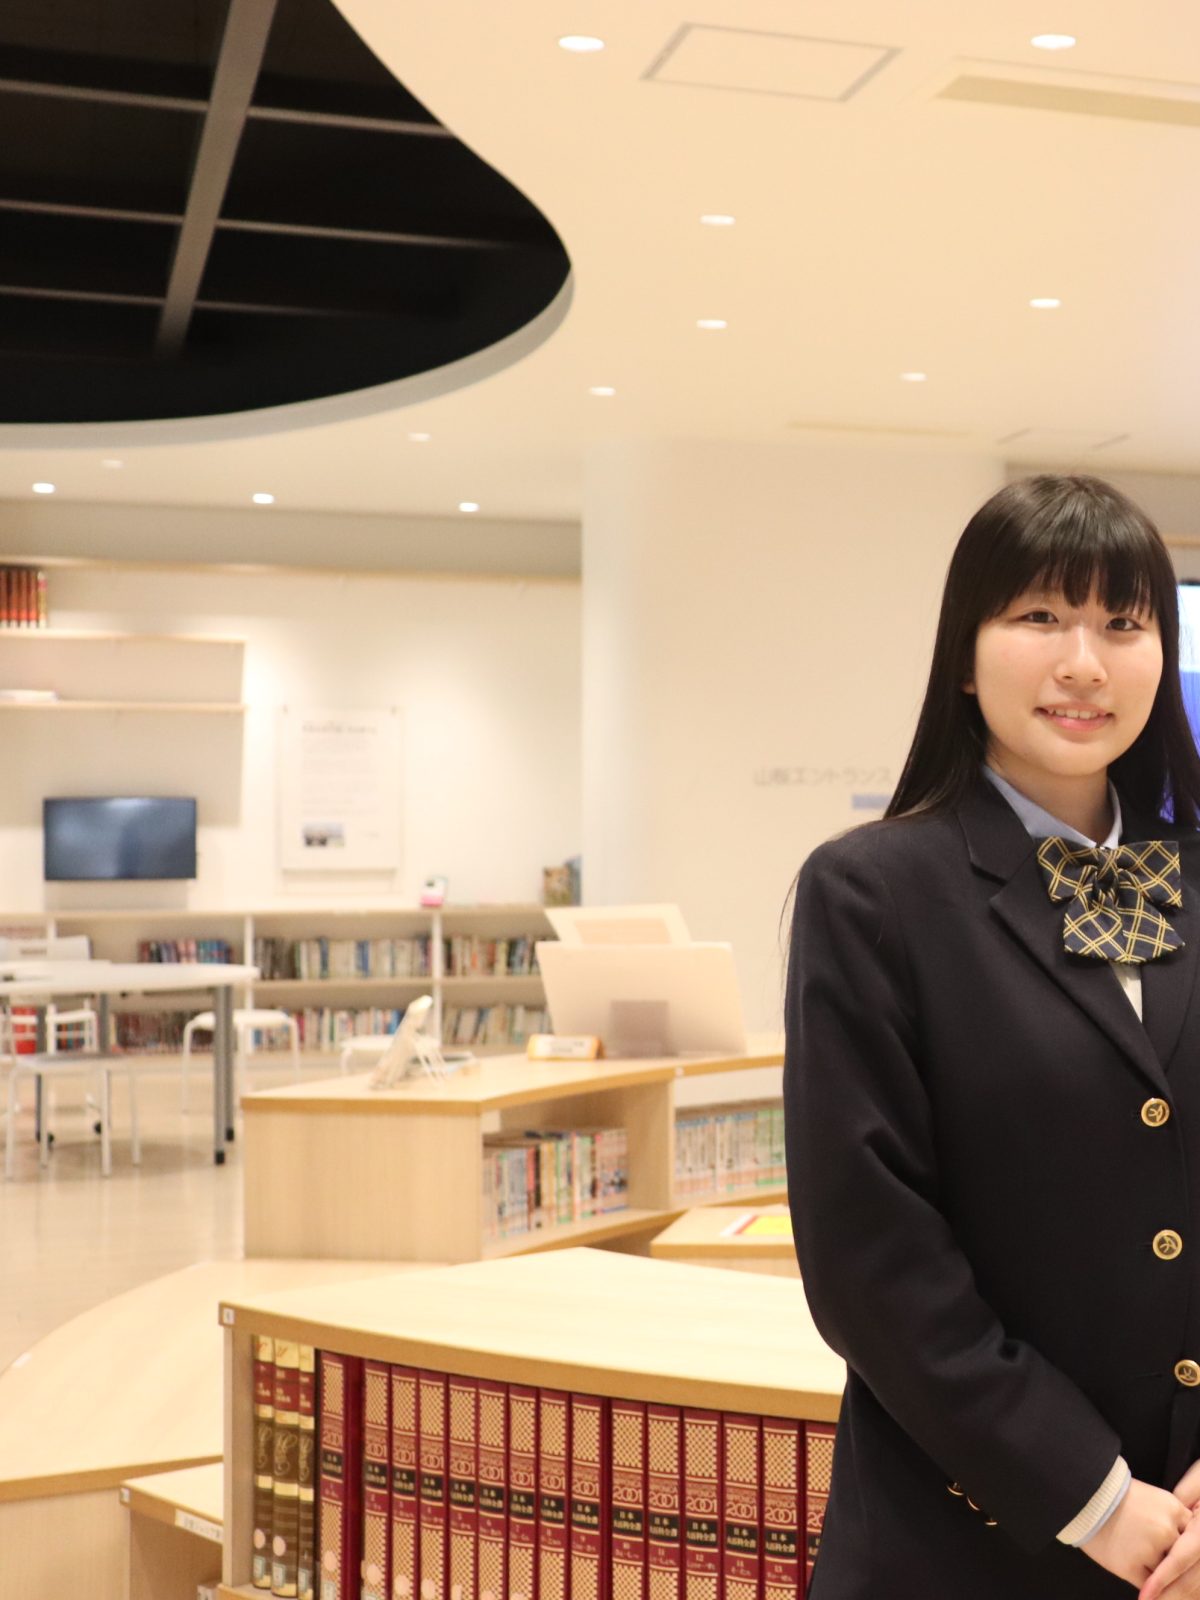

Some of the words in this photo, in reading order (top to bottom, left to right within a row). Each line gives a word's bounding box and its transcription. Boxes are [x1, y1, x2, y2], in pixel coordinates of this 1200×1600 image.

[613, 1485, 643, 1503] 2001
[649, 1491, 679, 1509] 2001
[686, 1496, 718, 1513] 2001
[726, 1501, 757, 1519] 2001
[765, 1507, 797, 1524] 2001
[808, 1511, 824, 1528] 20
